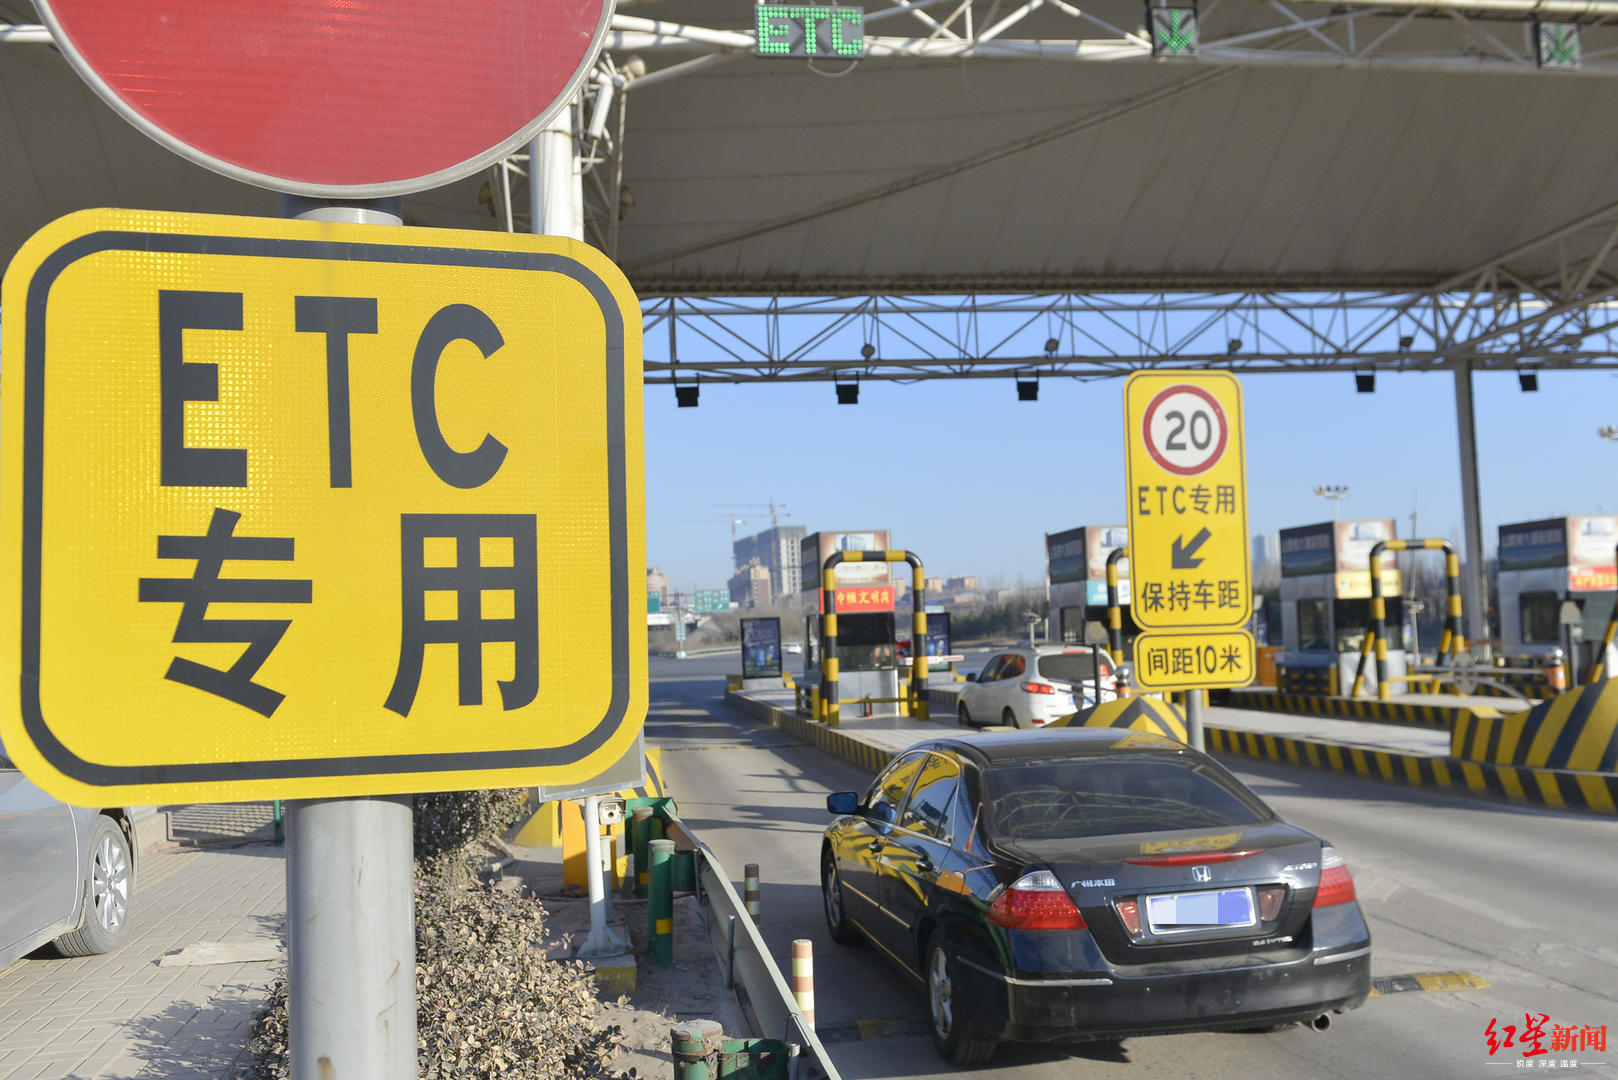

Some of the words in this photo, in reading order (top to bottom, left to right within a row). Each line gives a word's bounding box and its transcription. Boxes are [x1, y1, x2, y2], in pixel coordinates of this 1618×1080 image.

[758, 6, 862, 54] ETC
[158, 289, 509, 489] ETC
[1165, 410, 1212, 450] 20
[1138, 484, 1236, 516] ETC专用
[138, 507, 540, 719] 专用
[1141, 579, 1241, 613] 保持车距
[1147, 644, 1242, 677] 间距10米
[1071, 878, 1116, 888] 广州本田
